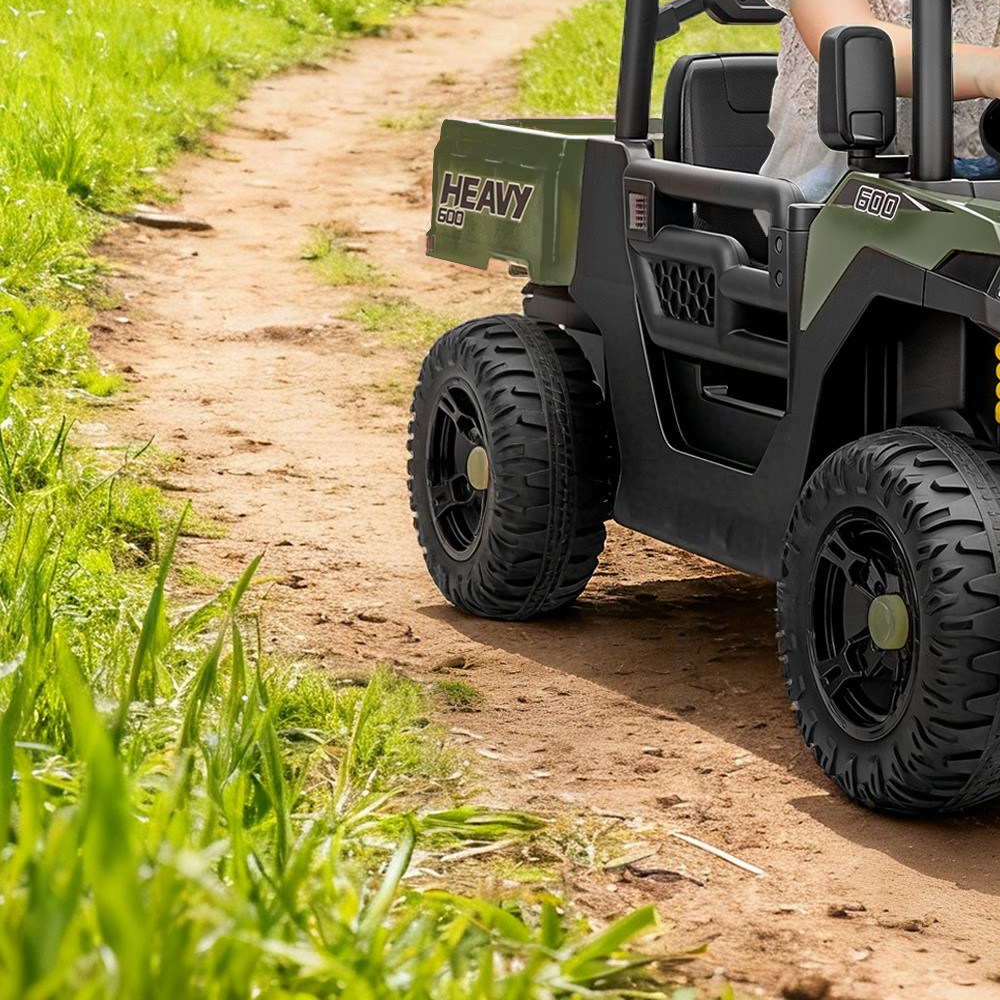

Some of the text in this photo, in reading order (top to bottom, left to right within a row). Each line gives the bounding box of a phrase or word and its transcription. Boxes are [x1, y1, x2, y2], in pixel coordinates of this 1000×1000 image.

[439, 171, 535, 222] HEAVY
[854, 185, 901, 221] 600
[437, 207, 465, 229] 600
